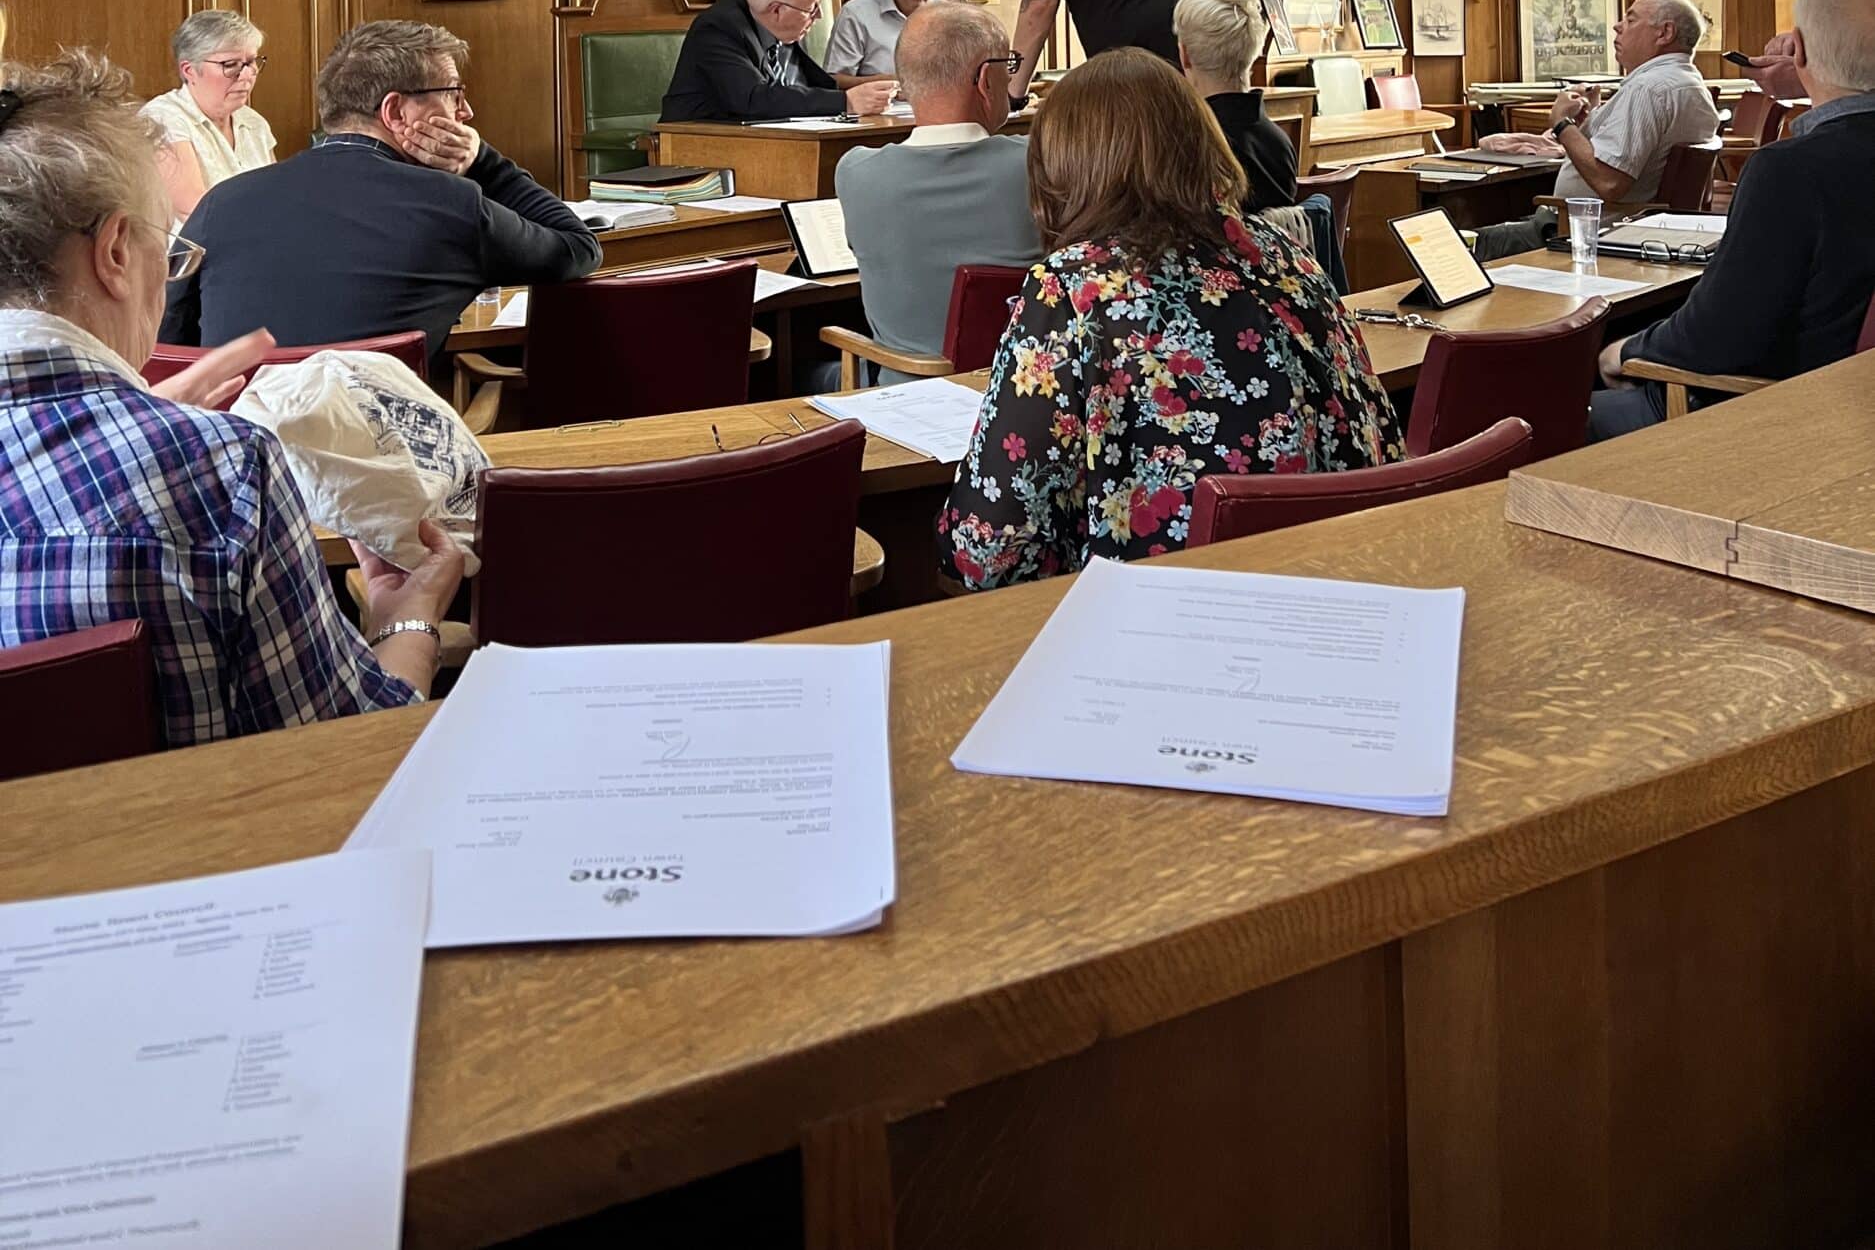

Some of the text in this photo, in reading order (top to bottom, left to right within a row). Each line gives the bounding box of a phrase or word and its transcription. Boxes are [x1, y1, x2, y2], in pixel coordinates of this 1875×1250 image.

[1157, 744, 1257, 765] Stone
[572, 855, 637, 866] Council
[568, 864, 684, 883] Stone
